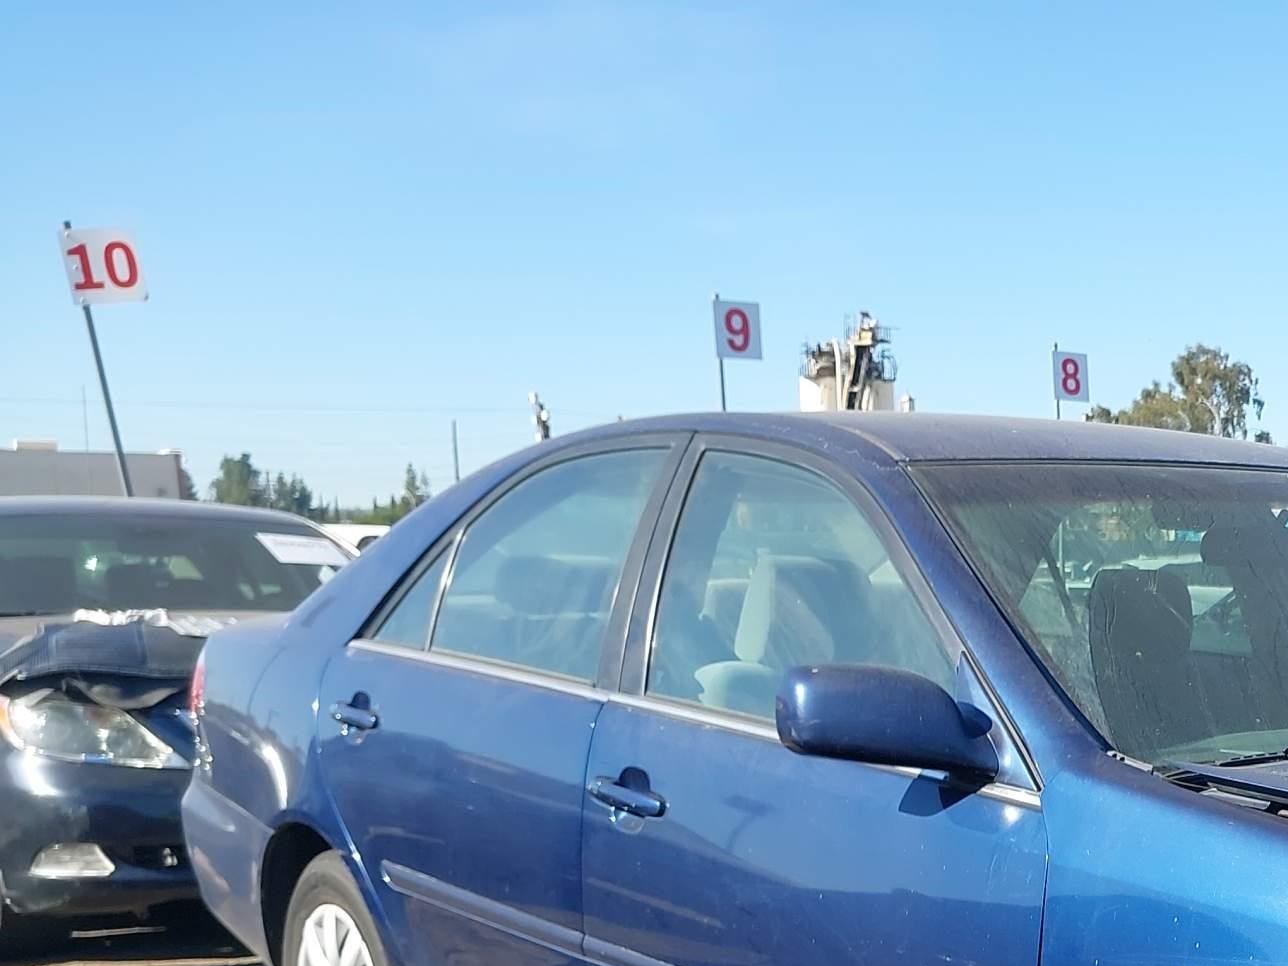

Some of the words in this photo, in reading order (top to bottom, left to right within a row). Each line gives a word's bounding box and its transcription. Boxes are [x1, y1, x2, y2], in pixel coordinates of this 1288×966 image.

[66, 240, 138, 290] 10
[724, 307, 751, 353] 9
[1060, 358, 1081, 396] 8
